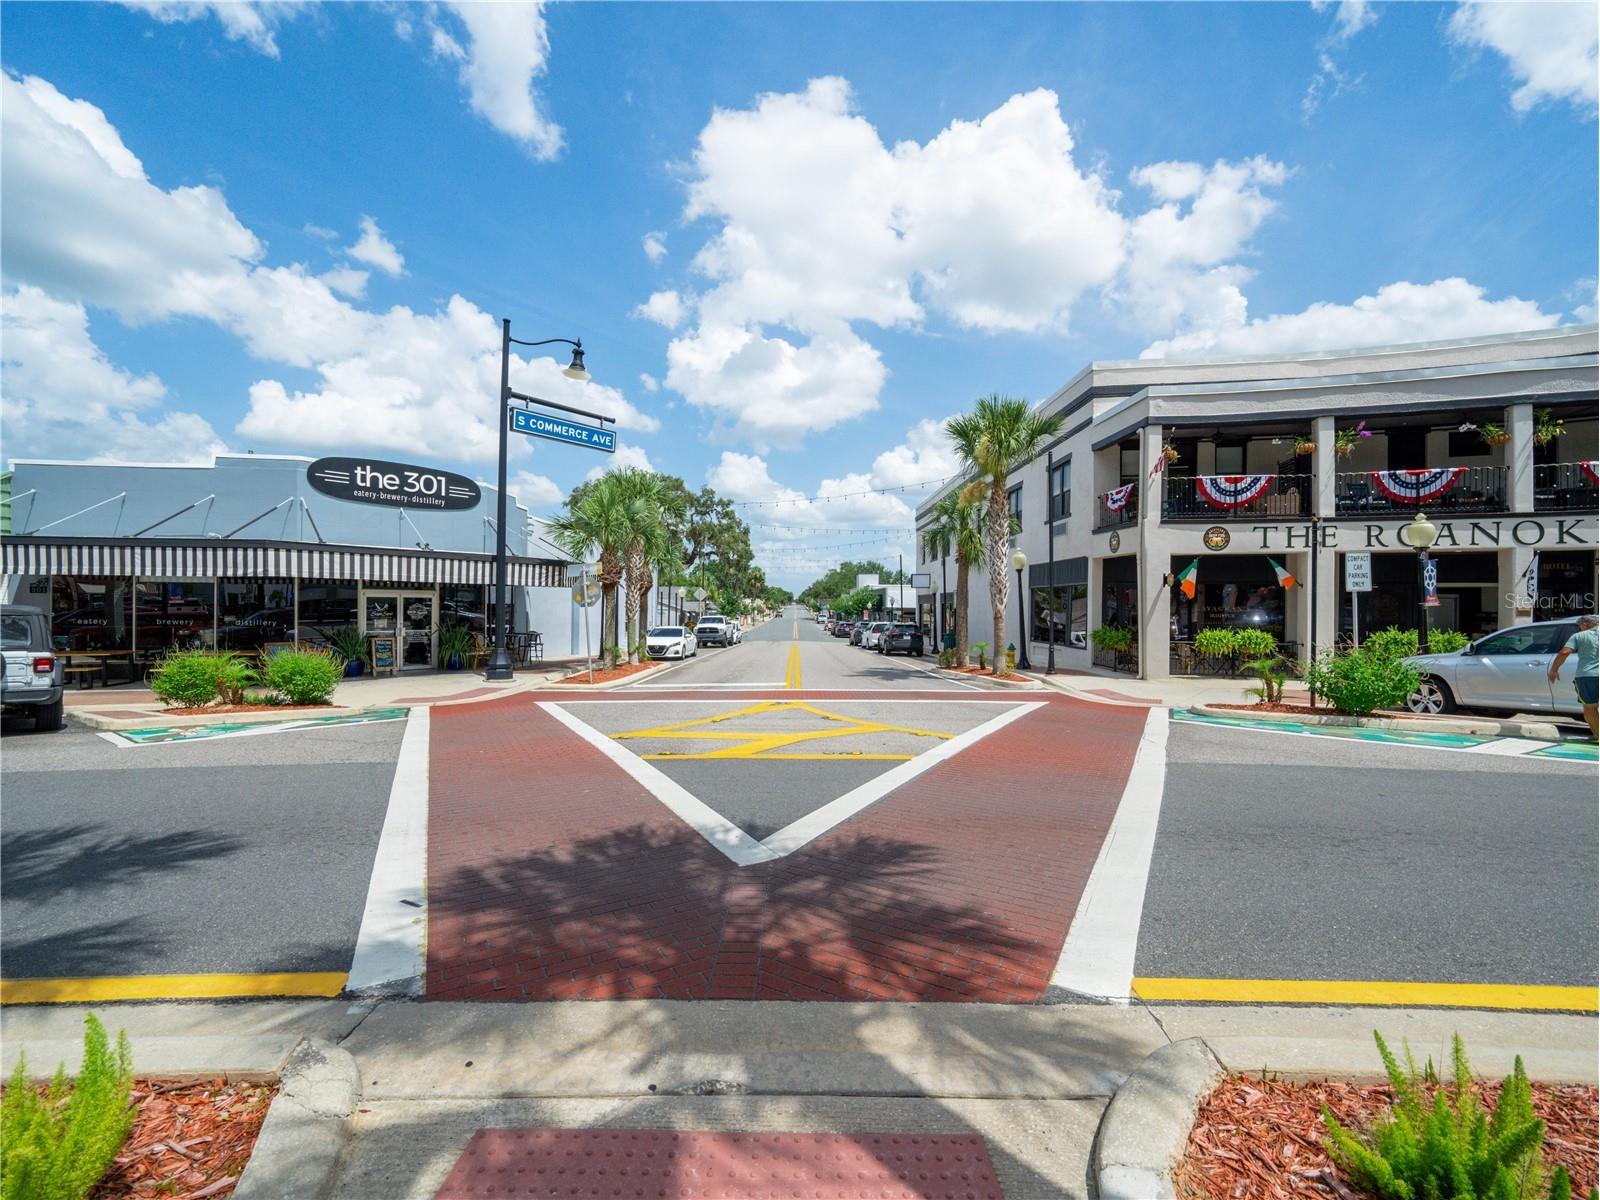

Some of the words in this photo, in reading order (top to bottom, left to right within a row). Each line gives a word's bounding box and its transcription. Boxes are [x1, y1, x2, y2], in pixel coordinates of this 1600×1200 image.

[518, 416, 525, 426] S
[529, 419, 588, 440] COMMERCE
[592, 434, 612, 446] AVE
[354, 465, 399, 490] the
[403, 471, 446, 496] 301
[1252, 525, 1338, 549] THE
[1364, 519, 1599, 548] RANOK
[77, 618, 108, 626] eatery
[156, 618, 194, 626] brewery
[235, 619, 277, 627] distillery
